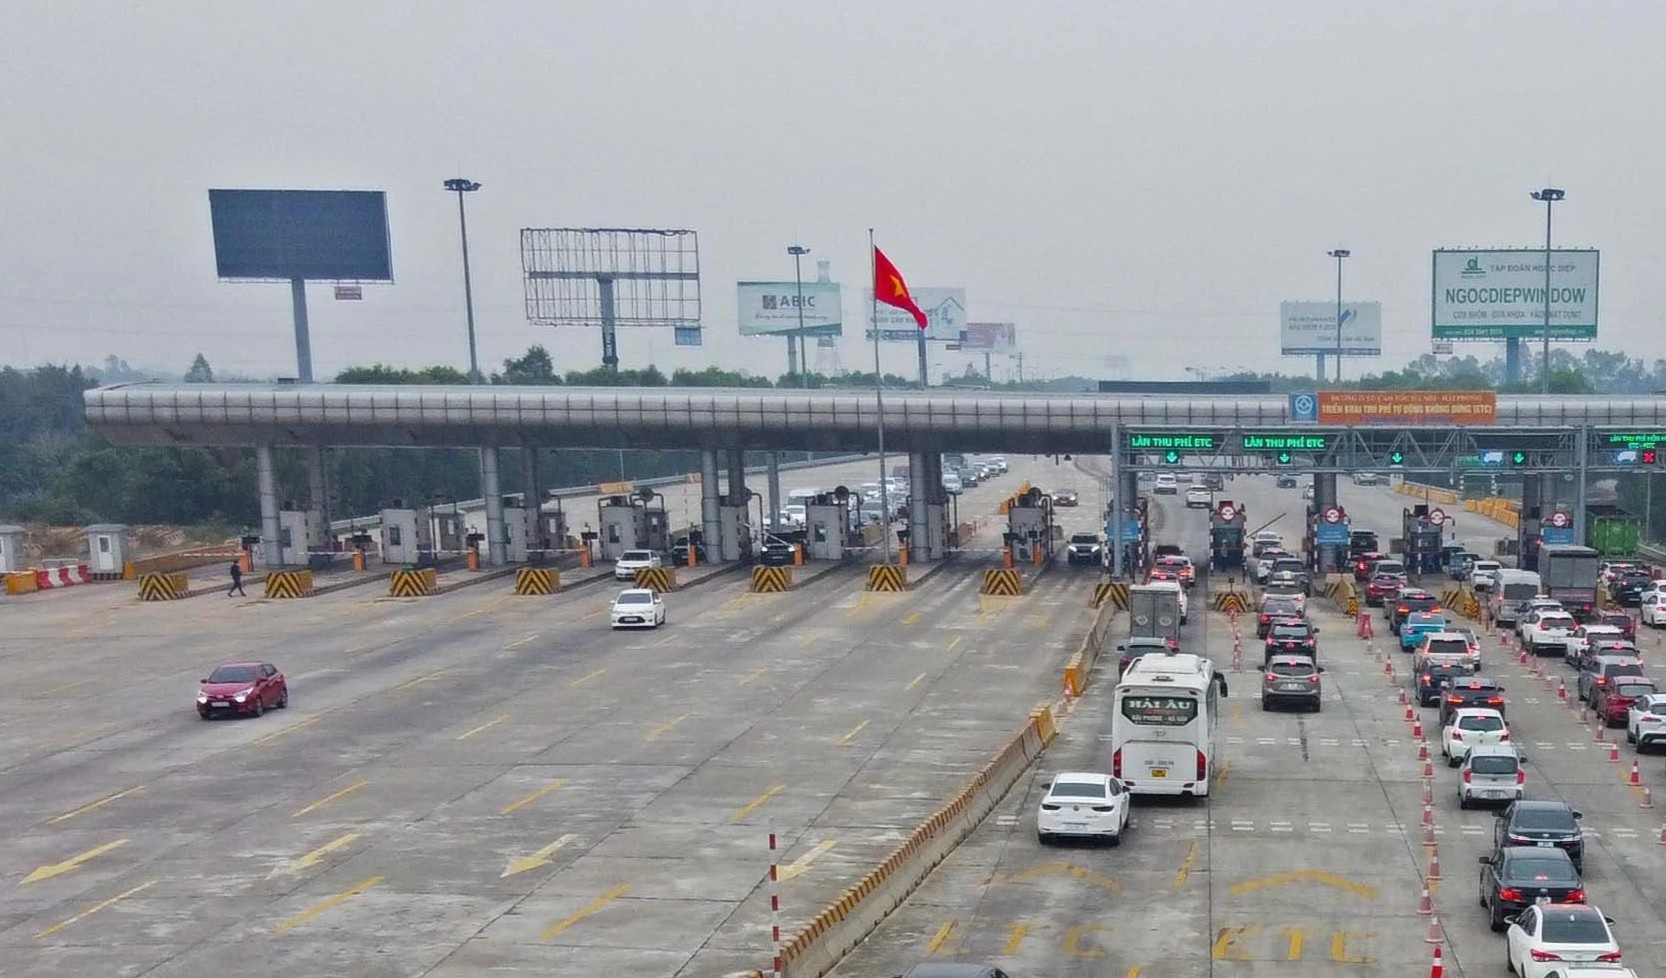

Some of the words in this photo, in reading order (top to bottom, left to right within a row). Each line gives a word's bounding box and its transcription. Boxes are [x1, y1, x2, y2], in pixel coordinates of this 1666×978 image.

[1132, 435, 1150, 447] LÀN
[1152, 437, 1172, 447] THU
[1174, 436, 1193, 447] PHÍ
[1194, 438, 1213, 448] ETC
[1244, 436, 1263, 448] LÀN
[1265, 438, 1284, 448] THU
[1286, 437, 1305, 448] PHÍ
[1306, 438, 1325, 448] ETC
[1128, 698, 1156, 709] HẢI
[1159, 698, 1191, 710] ÂU
